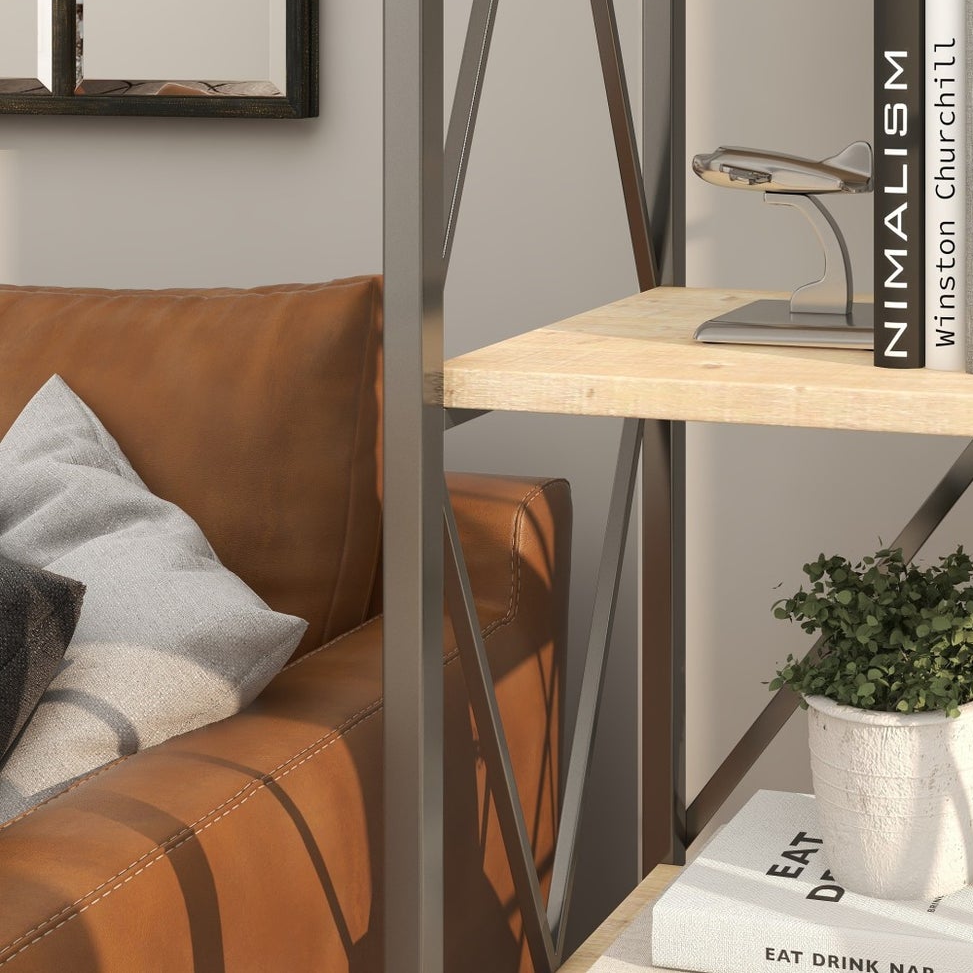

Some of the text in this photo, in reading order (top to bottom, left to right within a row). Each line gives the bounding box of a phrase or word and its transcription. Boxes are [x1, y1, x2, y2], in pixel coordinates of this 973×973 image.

[884, 50, 908, 358] NIMALISM
[934, 38, 956, 348] Winston Churchill
[765, 831, 824, 879] EAT
[765, 947, 803, 964] EAT
[812, 952, 879, 973] DRINK
